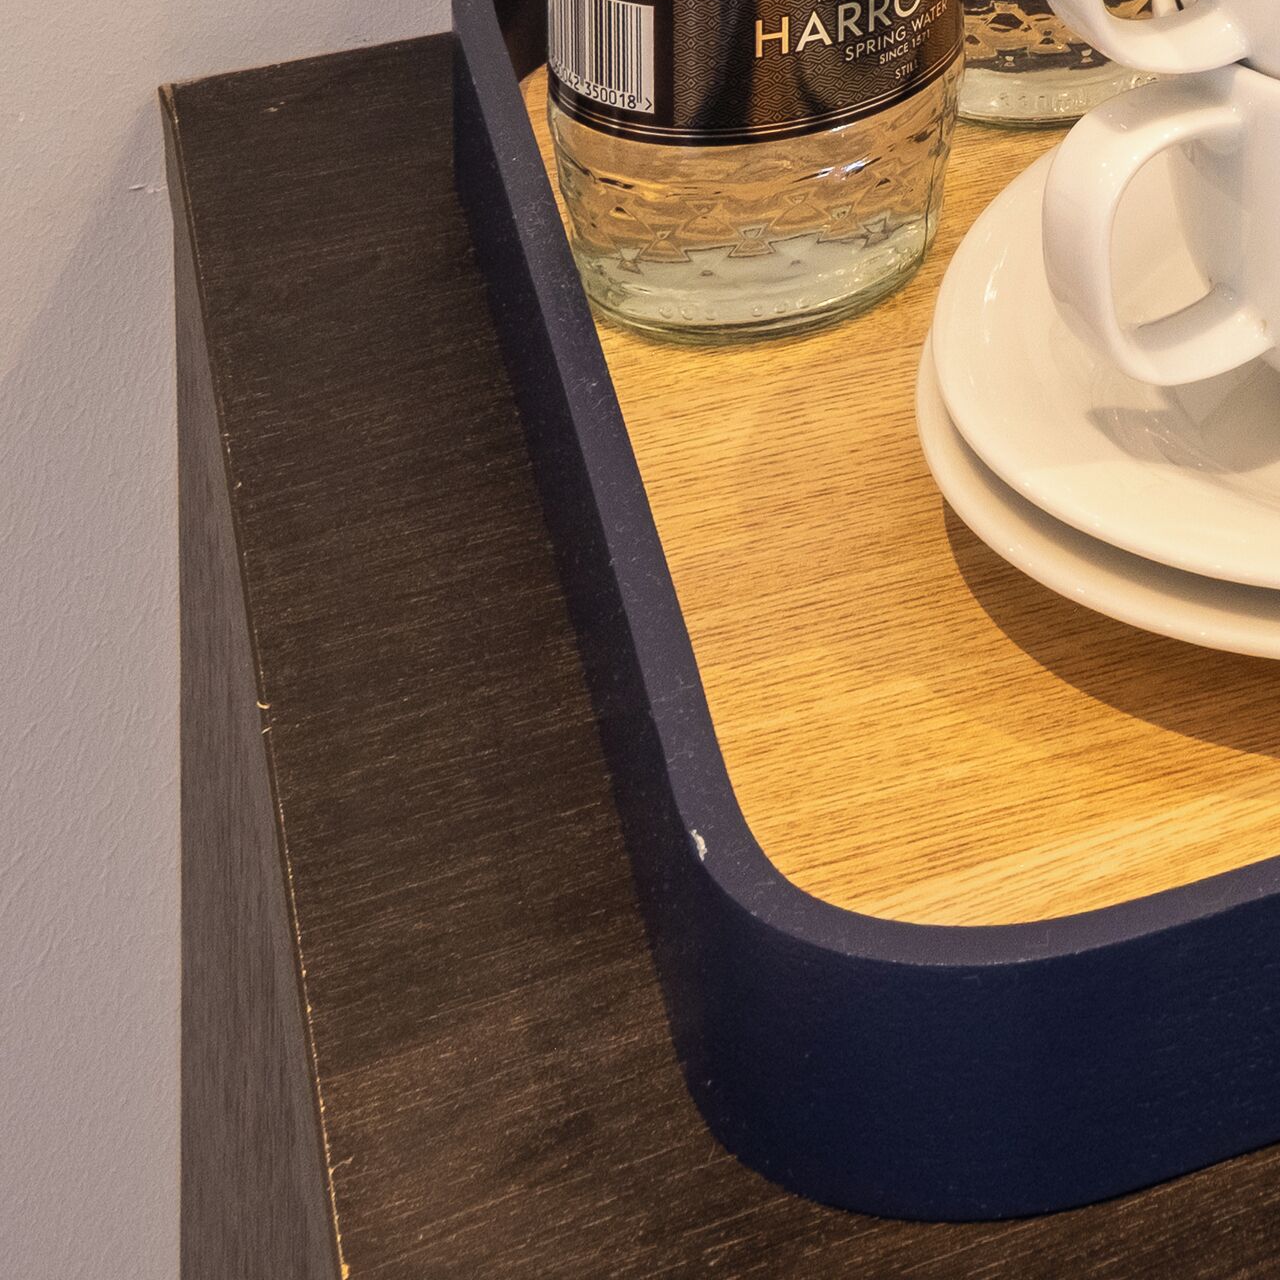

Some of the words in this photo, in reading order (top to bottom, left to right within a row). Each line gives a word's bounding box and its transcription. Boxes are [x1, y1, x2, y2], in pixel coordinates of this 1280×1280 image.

[844, 25, 907, 62] SPRING
[879, 42, 909, 65] SINCE
[584, 80, 637, 110] 350018
